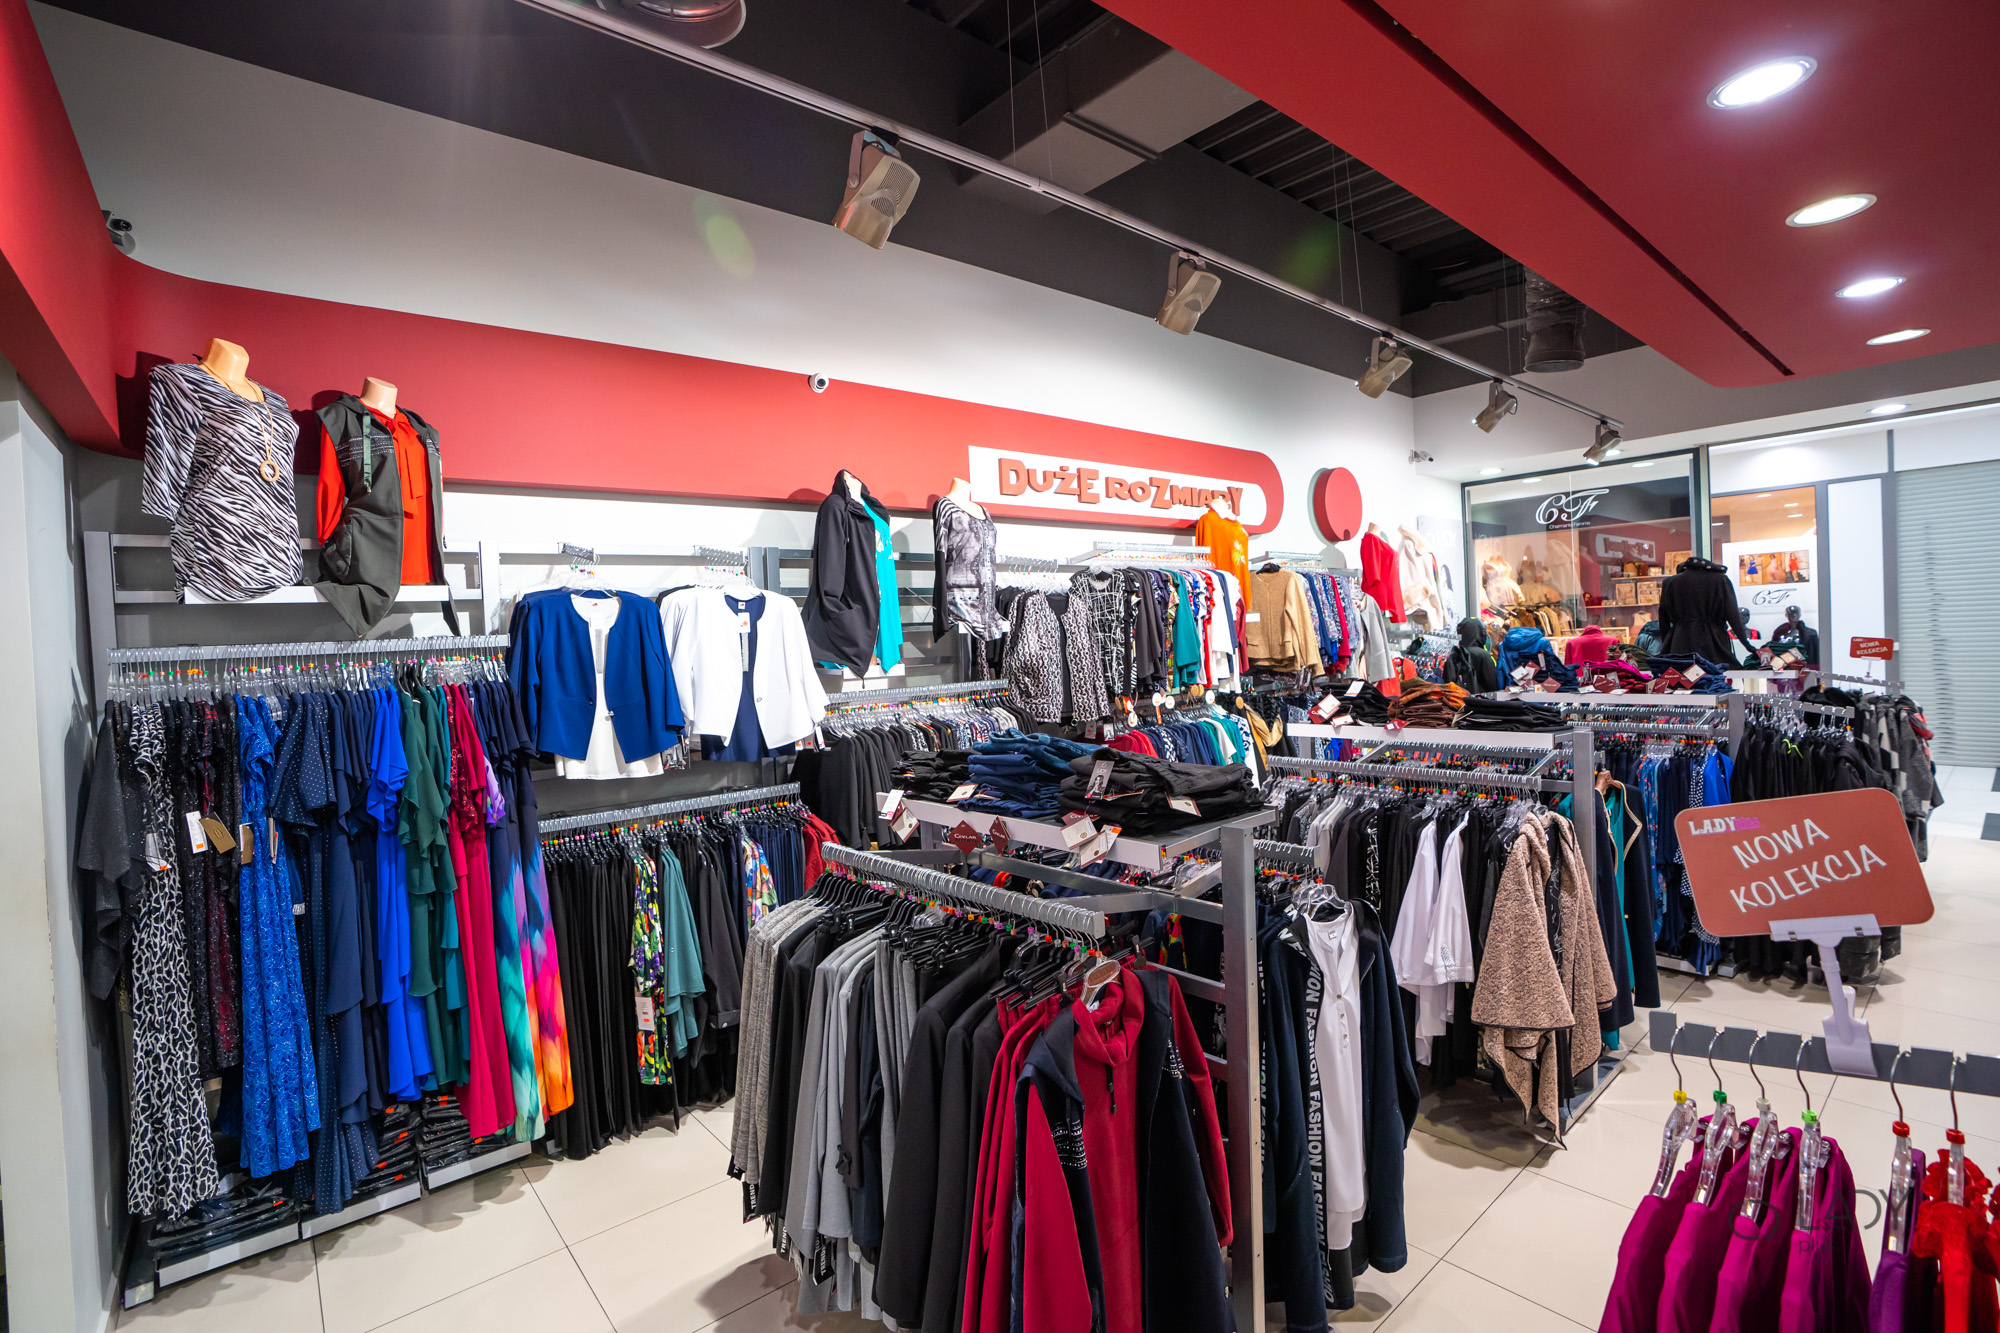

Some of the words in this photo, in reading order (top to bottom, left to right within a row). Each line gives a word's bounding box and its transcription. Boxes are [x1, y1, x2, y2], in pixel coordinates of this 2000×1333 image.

[997, 457, 1100, 504] DUŻE
[1688, 816, 1736, 836] LADY
[1731, 818, 1830, 869] NOWA
[1729, 844, 1887, 913] KOLEKCJA
[1307, 1091, 1323, 1168] FASHION
